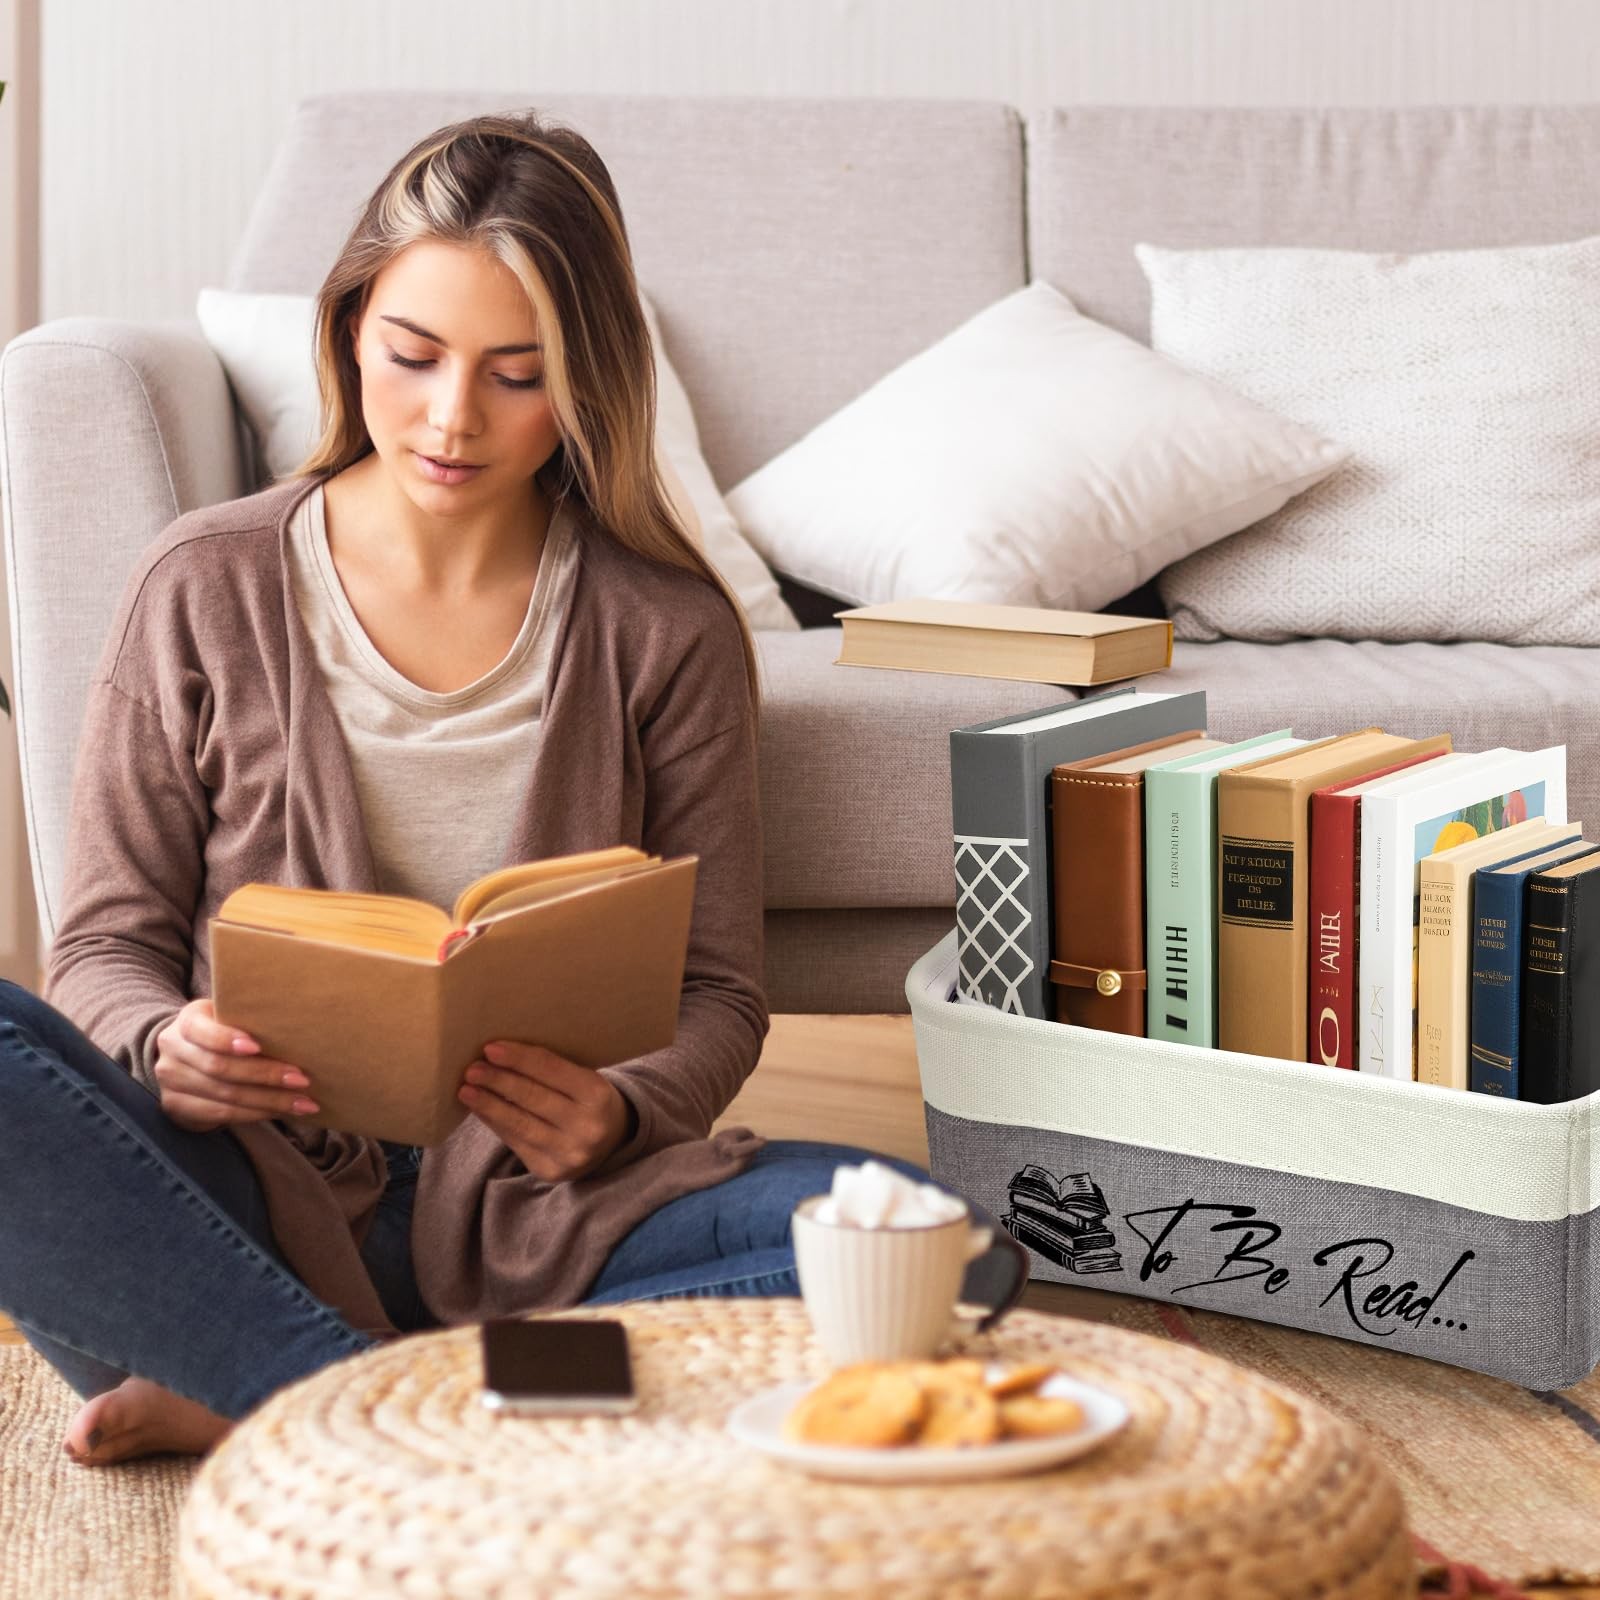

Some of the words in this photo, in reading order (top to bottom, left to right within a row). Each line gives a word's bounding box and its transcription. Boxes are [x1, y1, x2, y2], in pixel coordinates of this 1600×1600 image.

[1123, 1198, 1257, 1281] To
[1171, 1219, 1290, 1295] Be
[1313, 1238, 1476, 1336] Read...
